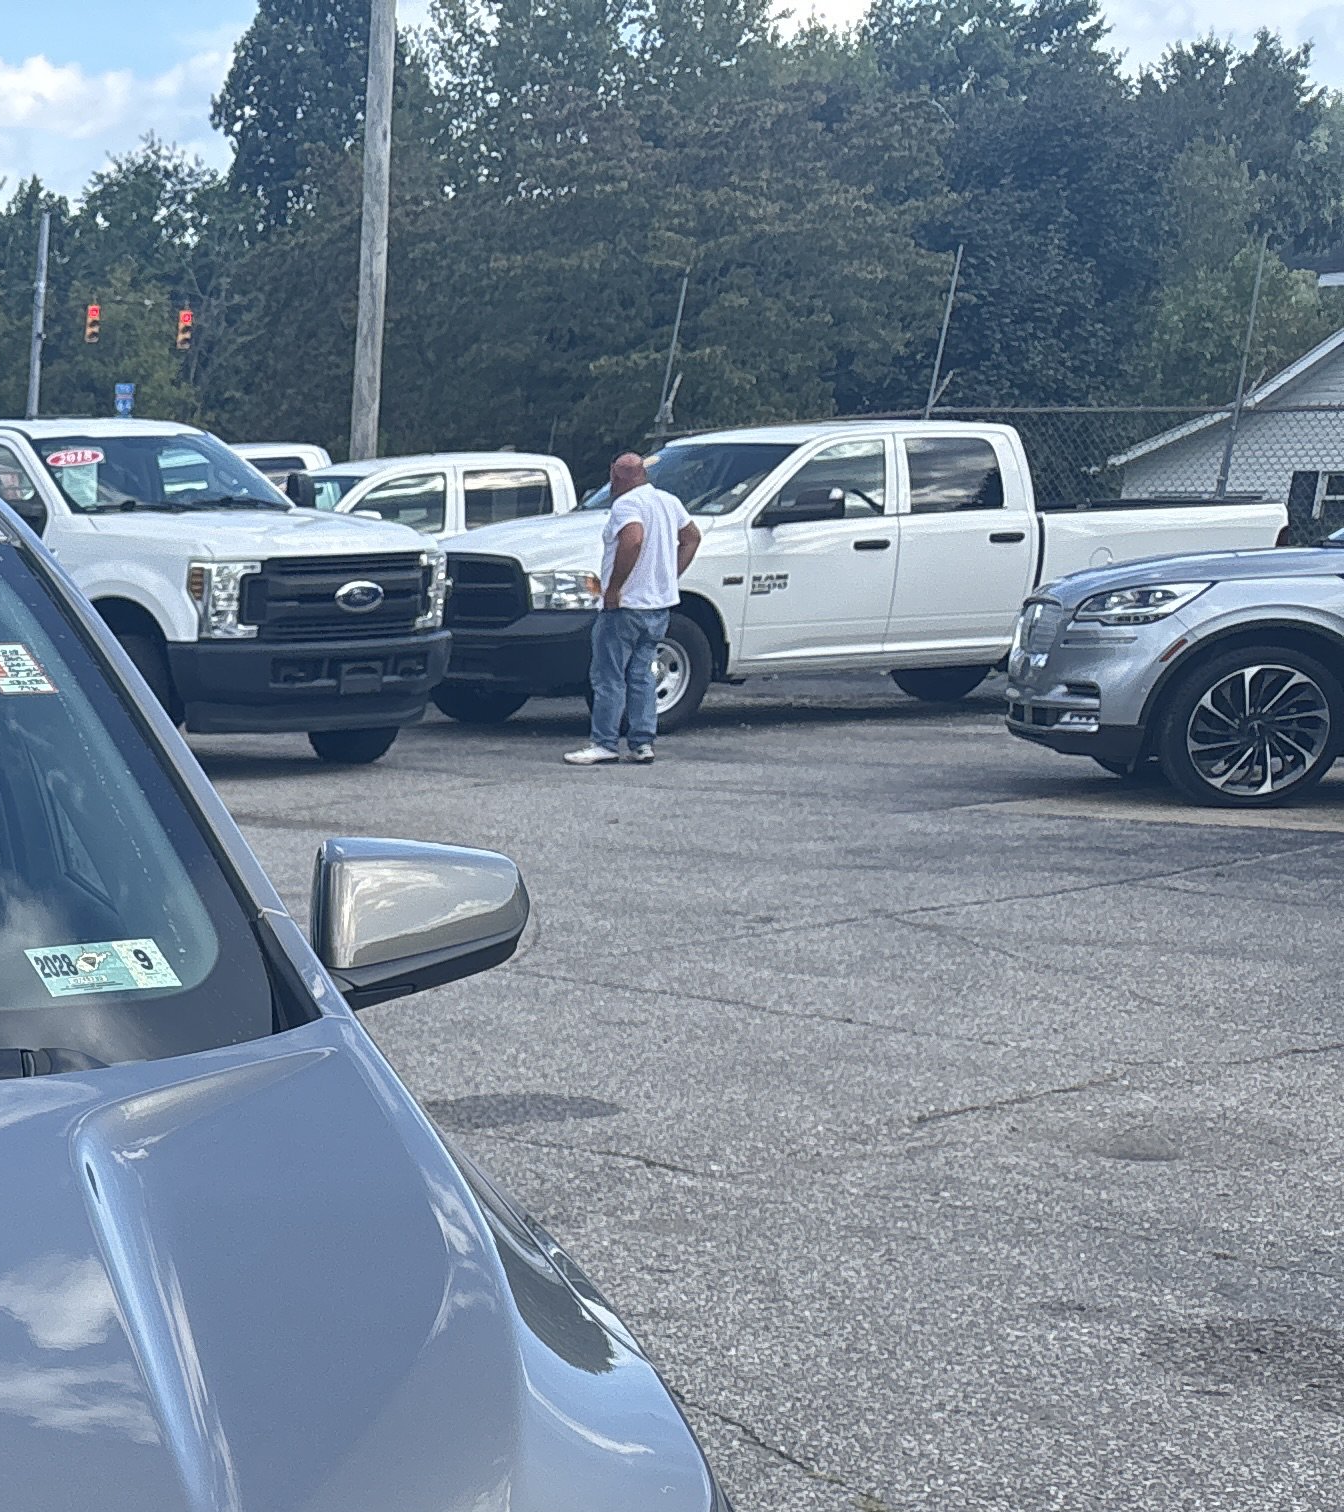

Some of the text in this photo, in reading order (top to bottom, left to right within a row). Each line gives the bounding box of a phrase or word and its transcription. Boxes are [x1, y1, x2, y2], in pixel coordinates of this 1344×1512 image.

[59, 450, 93, 465] 2018
[33, 948, 154, 979] 2028 9
